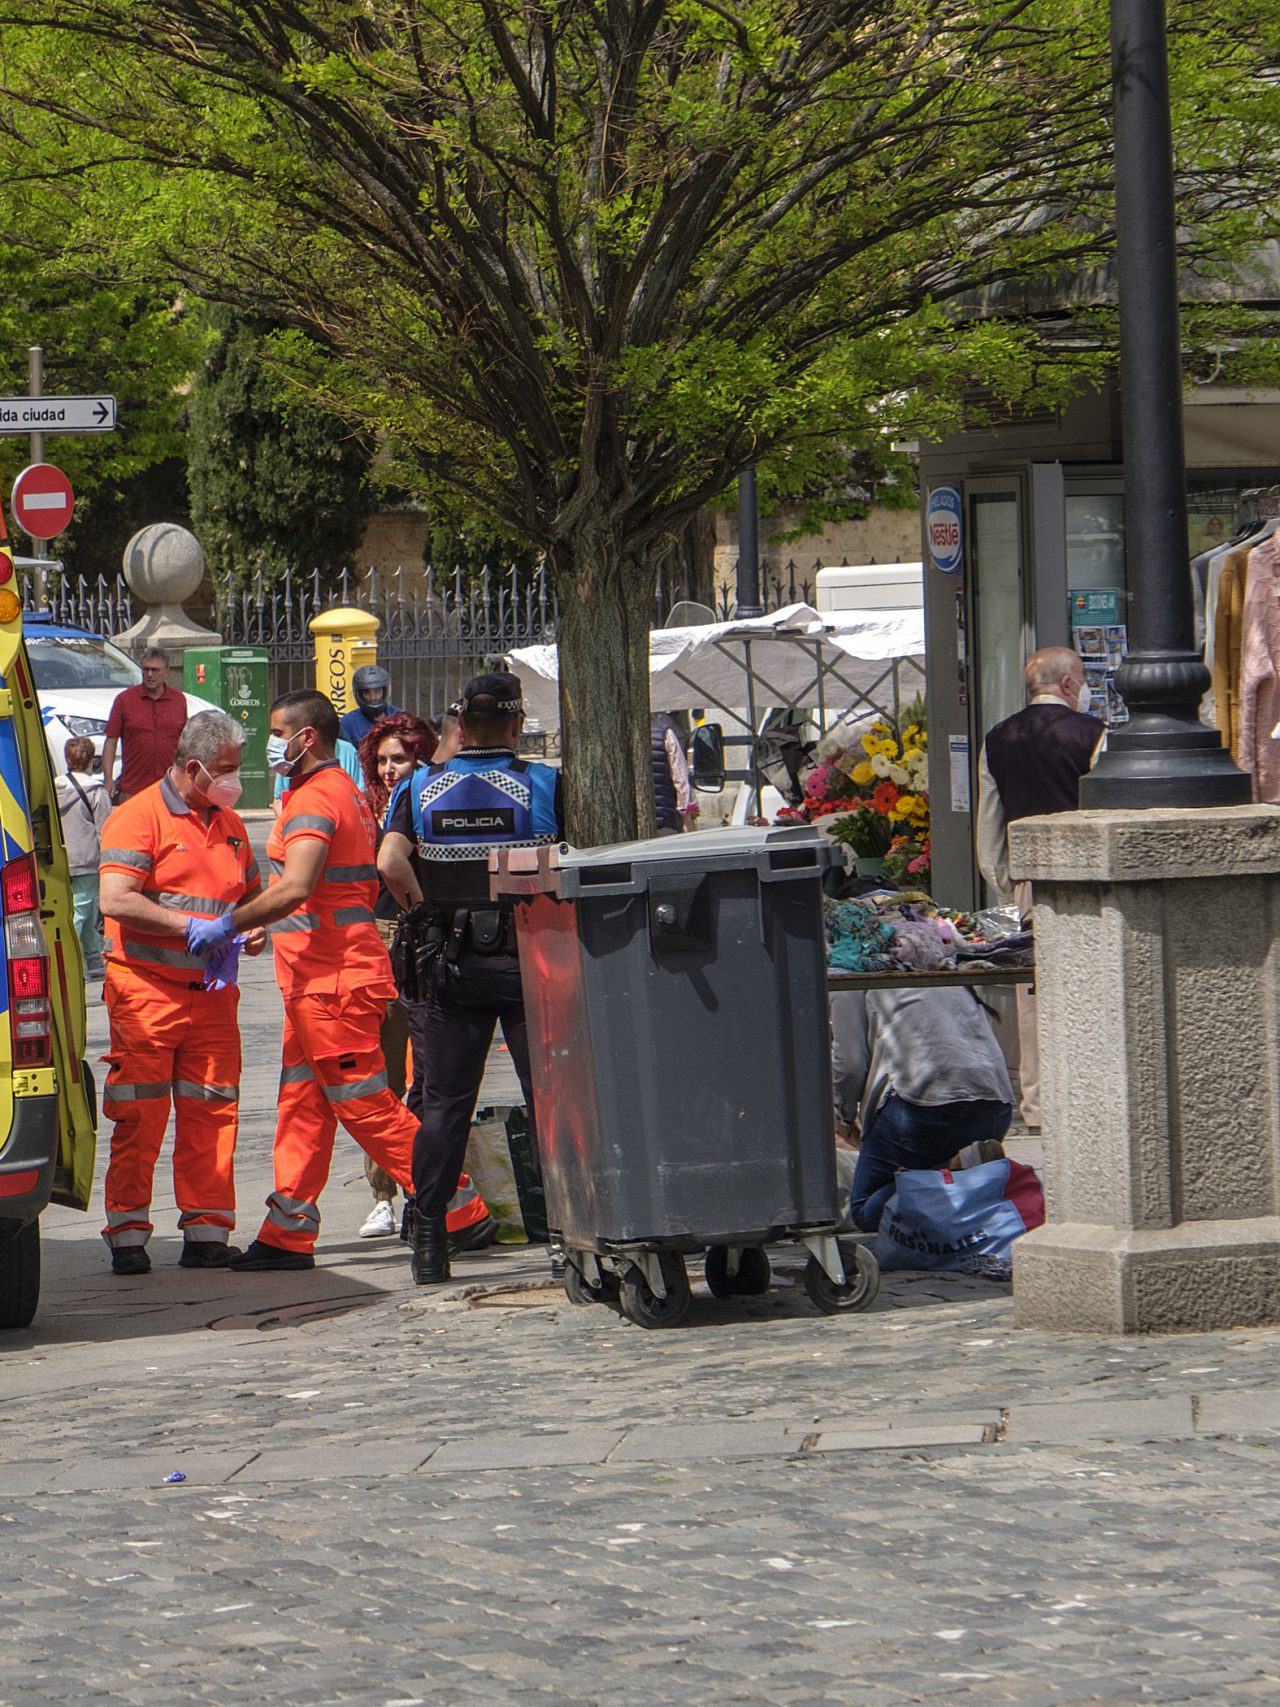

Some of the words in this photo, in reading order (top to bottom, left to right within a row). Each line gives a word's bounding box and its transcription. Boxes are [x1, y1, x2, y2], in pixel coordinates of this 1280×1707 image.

[22, 407, 66, 421] ciudad
[329, 648, 346, 716] RREOS
[442, 816, 505, 828] POLICIA
